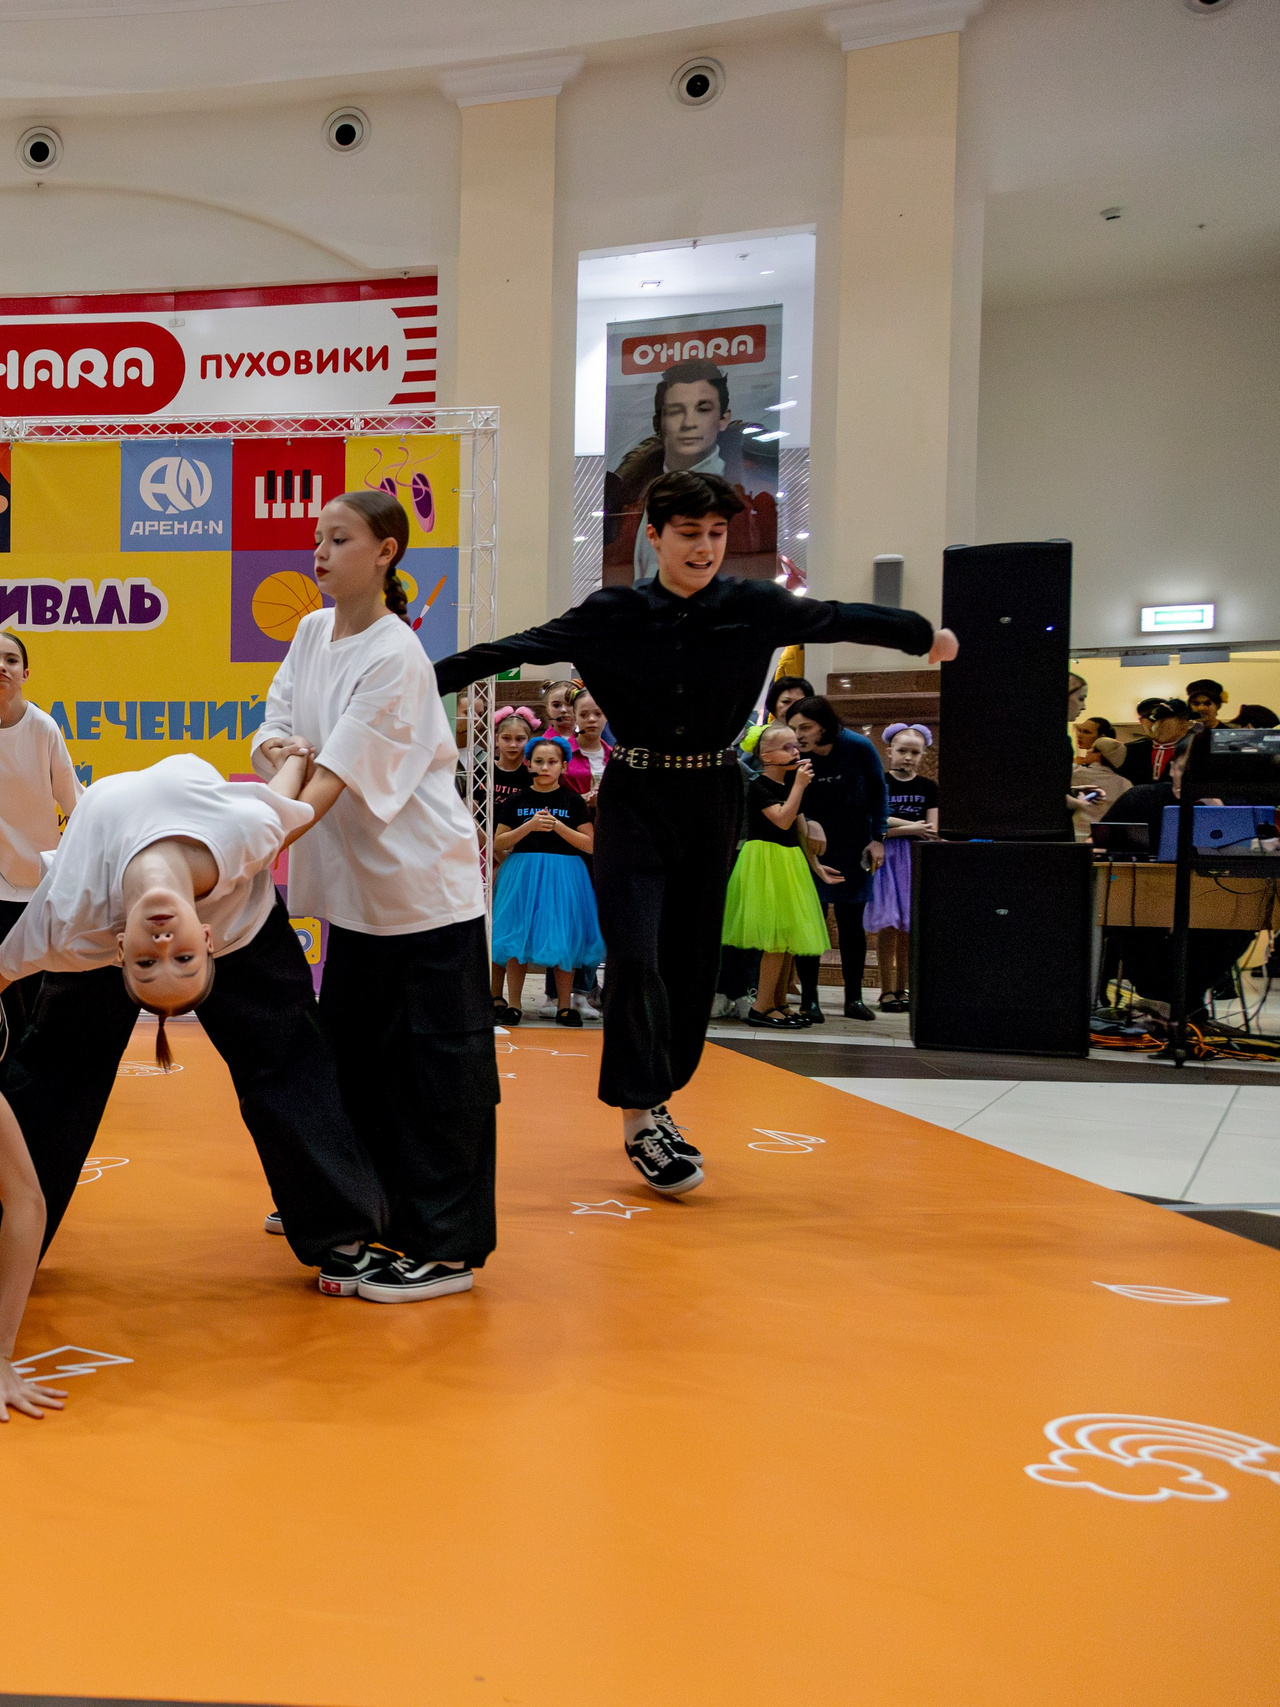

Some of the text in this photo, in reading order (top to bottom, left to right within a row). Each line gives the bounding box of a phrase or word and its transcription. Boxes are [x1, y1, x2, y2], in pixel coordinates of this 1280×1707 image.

[200, 345, 389, 379] ПУХОВИКИ
[633, 334, 754, 366] O'HARA
[517, 807, 570, 818] BEAUFUL
